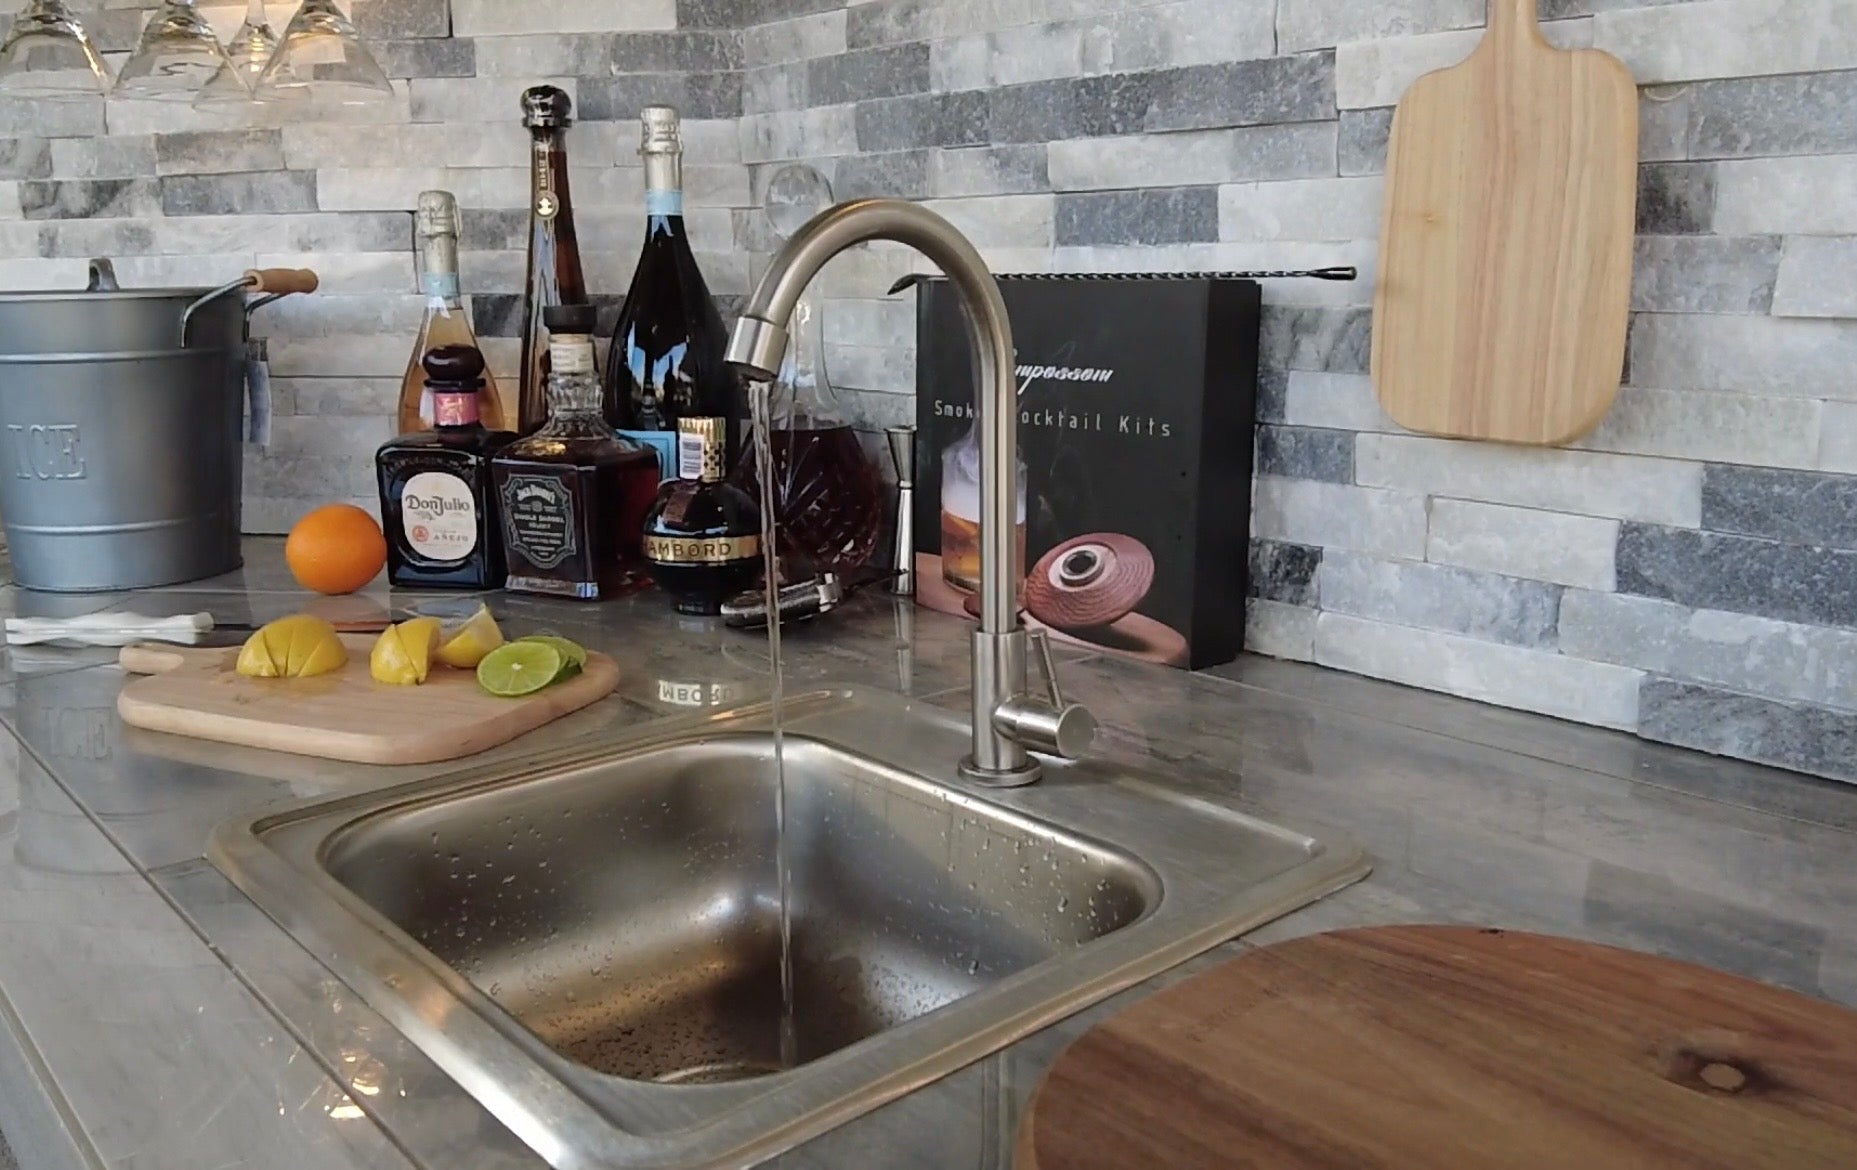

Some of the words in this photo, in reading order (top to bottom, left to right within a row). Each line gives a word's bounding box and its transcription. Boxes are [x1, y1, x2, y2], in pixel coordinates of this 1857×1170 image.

[1012, 348, 1114, 395] mpossom
[934, 399, 981, 418] Smok
[1021, 409, 1101, 431] ocktail
[1118, 415, 1171, 437] Kits
[7, 424, 87, 480] ICE
